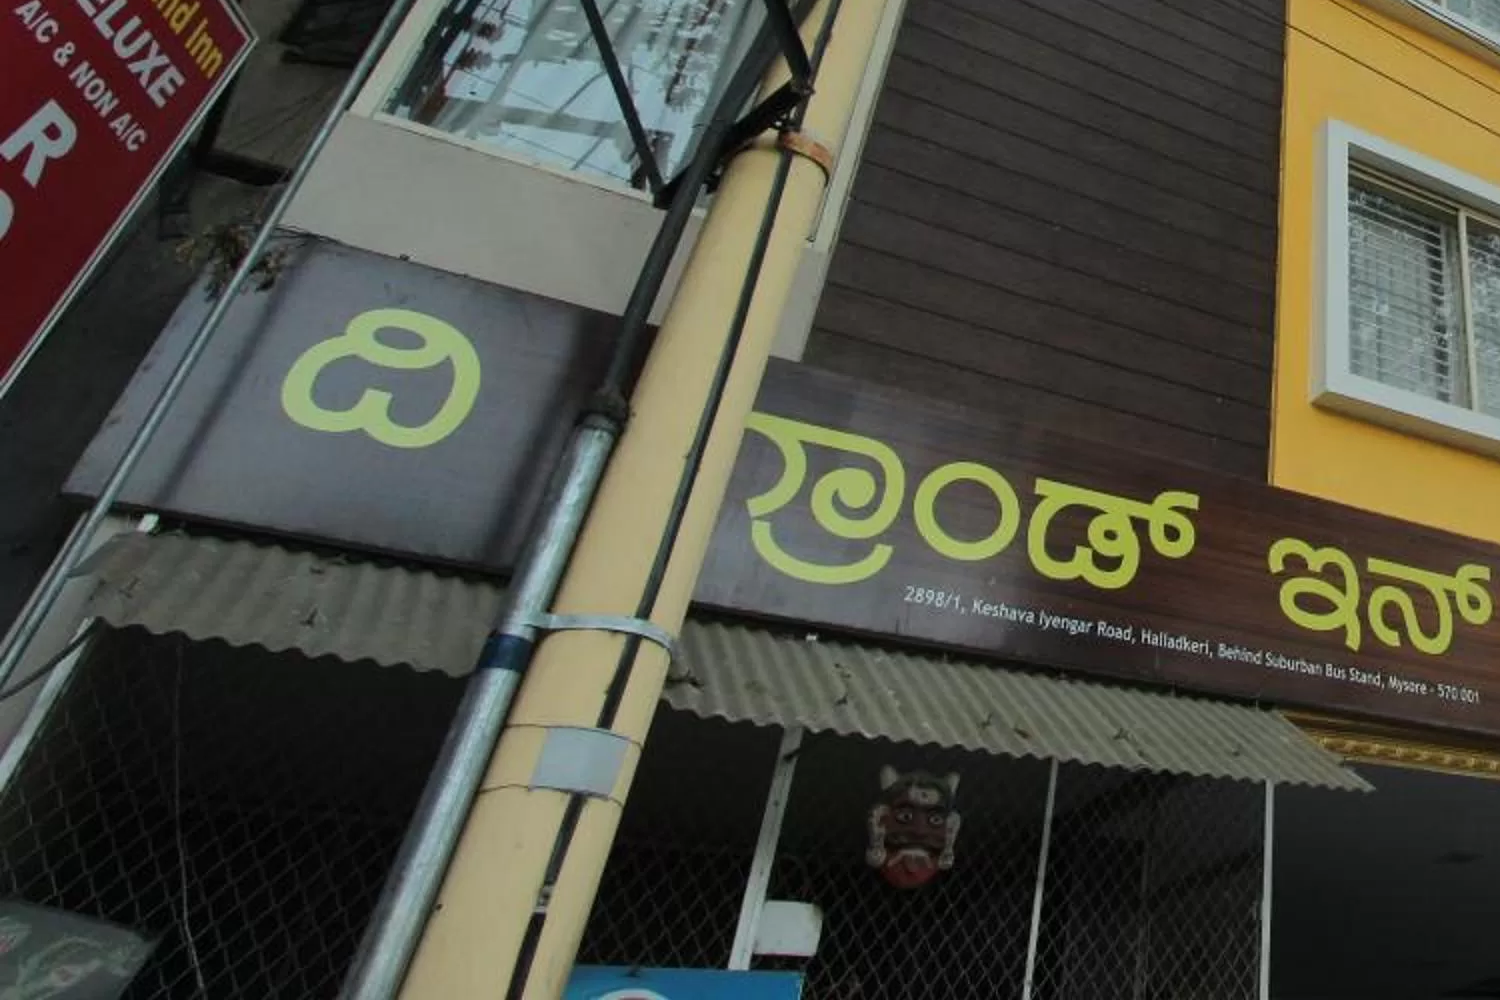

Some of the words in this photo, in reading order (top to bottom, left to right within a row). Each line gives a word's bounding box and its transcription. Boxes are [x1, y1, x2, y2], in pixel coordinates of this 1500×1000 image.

[52, 42, 75, 67] &
[69, 60, 117, 117] NON
[904, 585, 966, 615] 2898/1,
[972, 599, 1035, 624] Keshava
[1039, 608, 1093, 636] Iyengar
[1097, 621, 1137, 644] Road,
[1141, 628, 1214, 658] Halladkeri,
[1217, 643, 1262, 666] Behind
[1265, 652, 1323, 677] Suburban
[1325, 663, 1347, 681] Bus
[1350, 667, 1386, 689] Stand,
[1388, 675, 1428, 696] Mysore
[1437, 682, 1459, 701] 570
[1459, 686, 1481, 704] 001
[1268, 536, 1493, 656] ಇನ್
